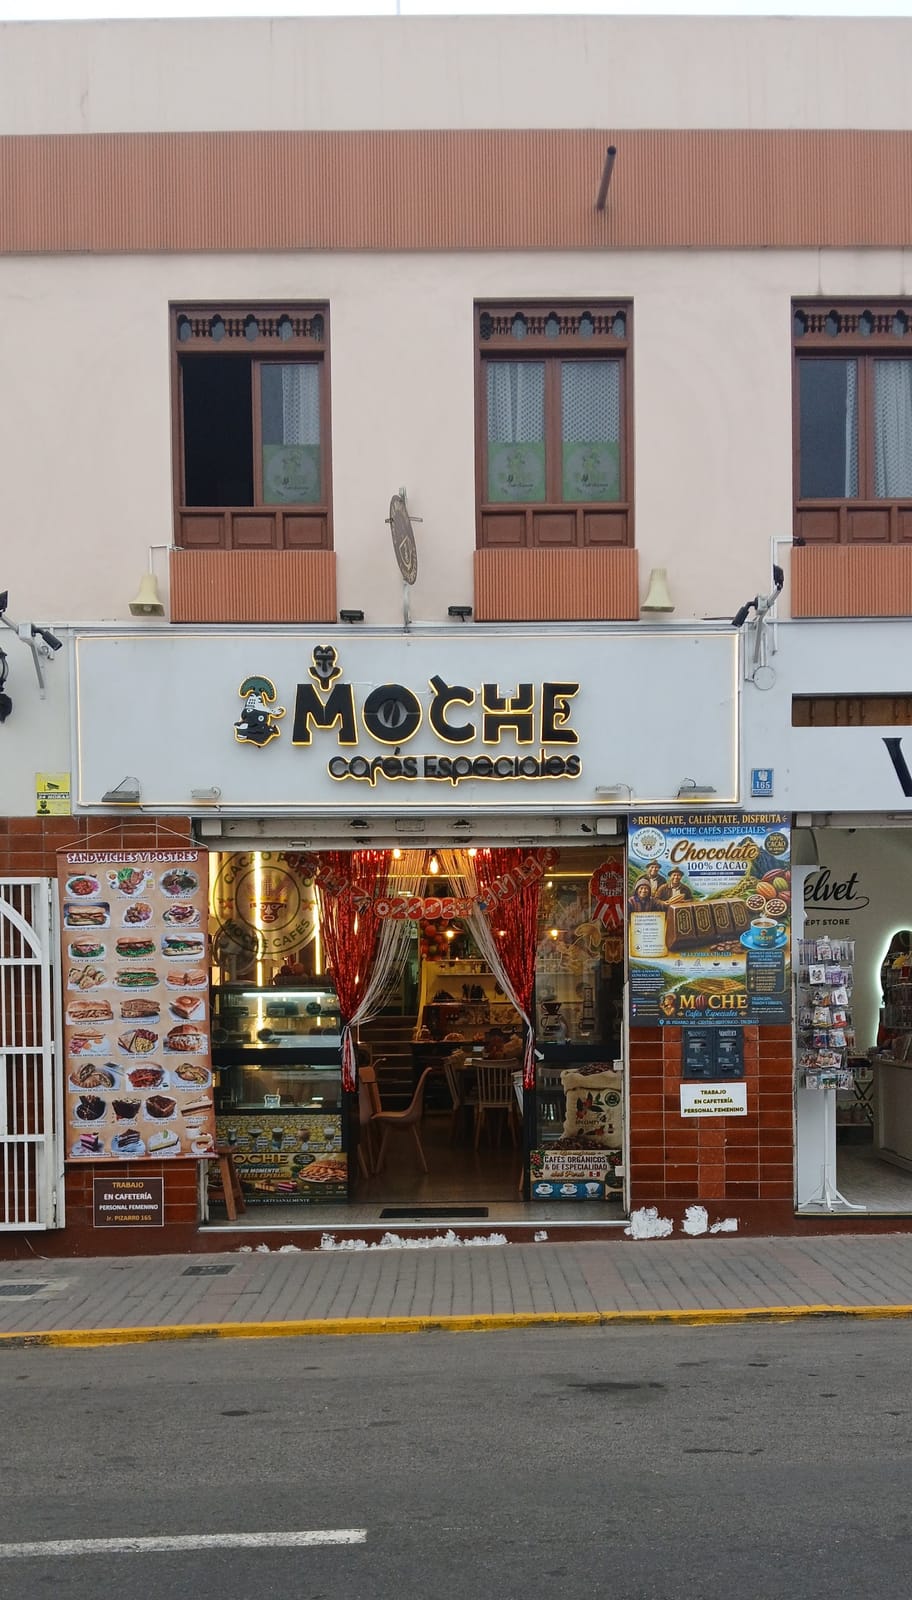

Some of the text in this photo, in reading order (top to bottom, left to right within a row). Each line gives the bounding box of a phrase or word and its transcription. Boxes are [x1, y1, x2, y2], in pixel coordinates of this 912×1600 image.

[291, 675, 580, 745] MOCHE
[423, 749, 582, 786] Especiales
[755, 781, 771, 790] 165
[742, 813, 782, 824] DISFRUTA
[670, 826, 766, 835] MOCHE CAFÉS ESPECIALES
[67, 851, 137, 864] SANDWICHES
[149, 850, 199, 863] POSTRES
[670, 839, 760, 864] Chocolate
[687, 861, 749, 871] 100% CACAO
[803, 866, 860, 902] elvet
[822, 918, 850, 926] STORE
[272, 918, 311, 947] CAFÉS
[232, 1153, 289, 1165] OCHE
[568, 1155, 606, 1163] ORGÁNICOS
[114, 1191, 152, 1200] CAFETERÍA
